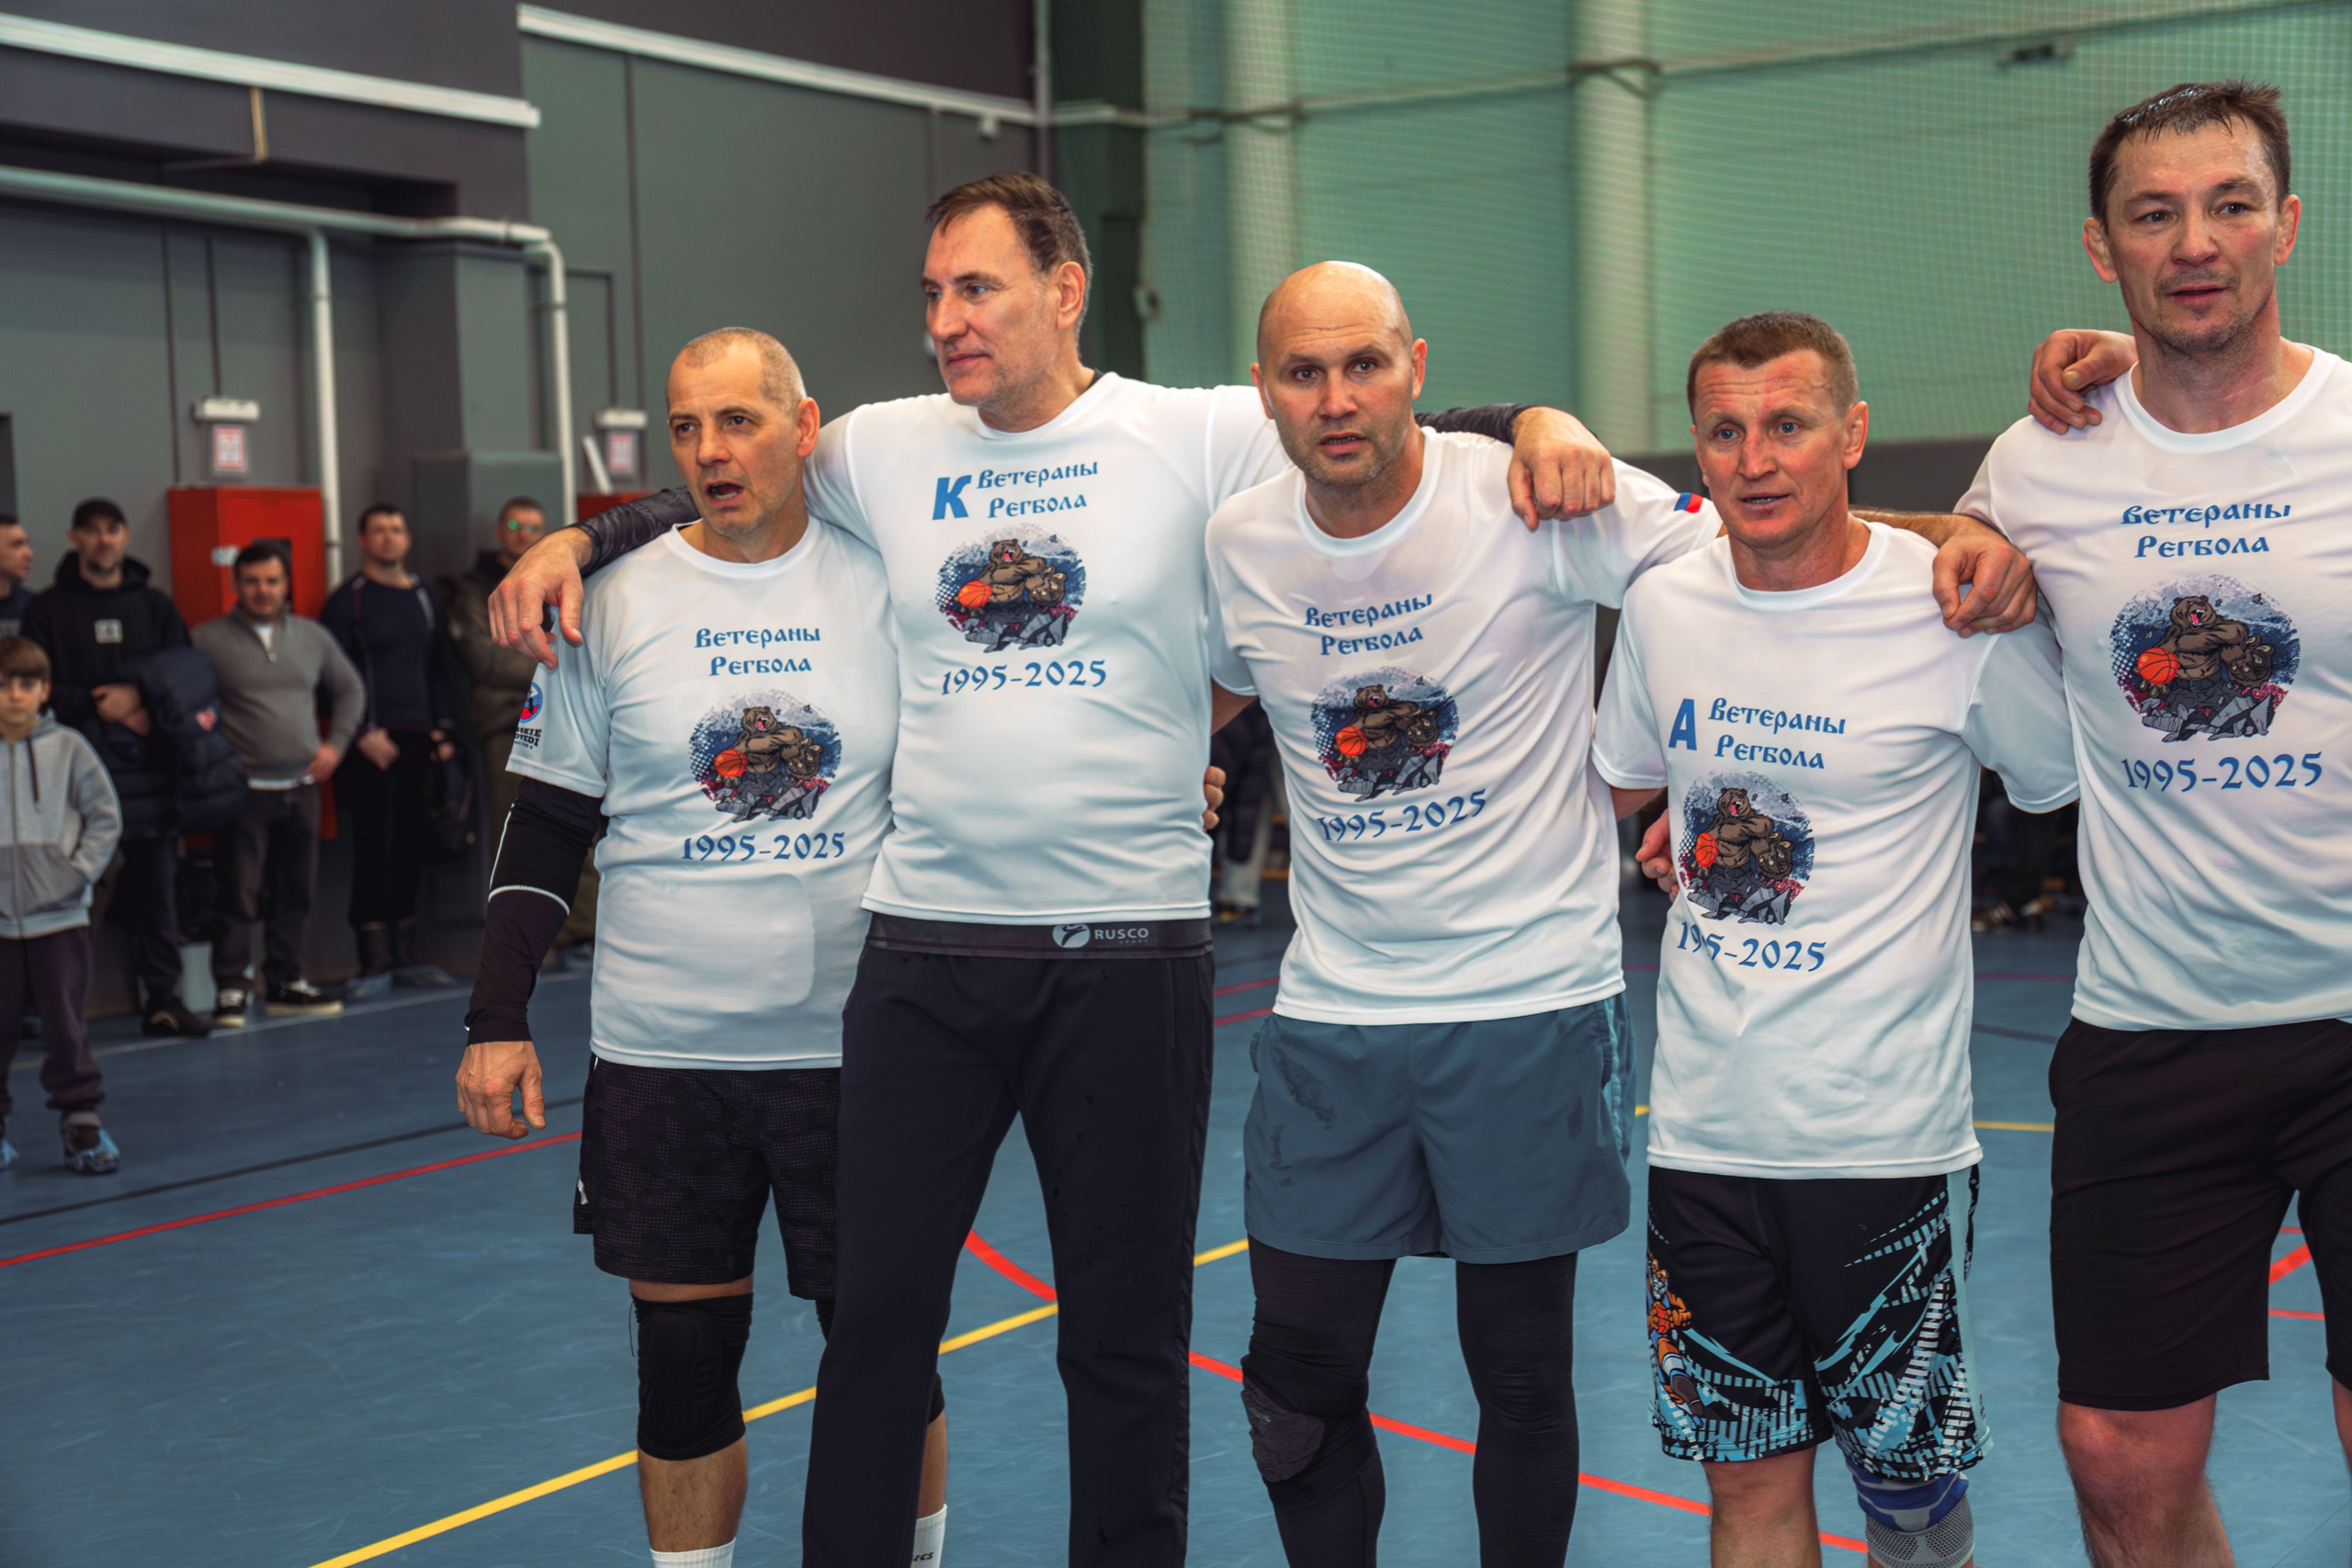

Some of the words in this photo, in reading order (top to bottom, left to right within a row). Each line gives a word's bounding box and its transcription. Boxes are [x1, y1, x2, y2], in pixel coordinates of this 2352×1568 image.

[977, 462, 1098, 490] Ветераны
[932, 474, 972, 521] К
[987, 494, 1087, 518] Регбола
[2120, 502, 2291, 528] Ветераны
[2134, 536, 2269, 558] Регбола
[1304, 593, 1432, 627] Ветераны
[695, 626, 820, 649] Ветераны
[1320, 627, 1423, 655] Регбола
[709, 656, 812, 676] Регбола
[942, 660, 1107, 695] 1995-2025
[1668, 698, 1697, 750] А
[1708, 697, 1846, 735] Ветераны
[1714, 735, 1825, 769] Регбола
[2121, 751, 2323, 792] 1995-2025
[1317, 788, 1487, 841] 1995-2025
[681, 831, 845, 862] 1995-2025
[1094, 928, 1148, 940] RUSCO
[1677, 921, 1826, 972] 195-2025
